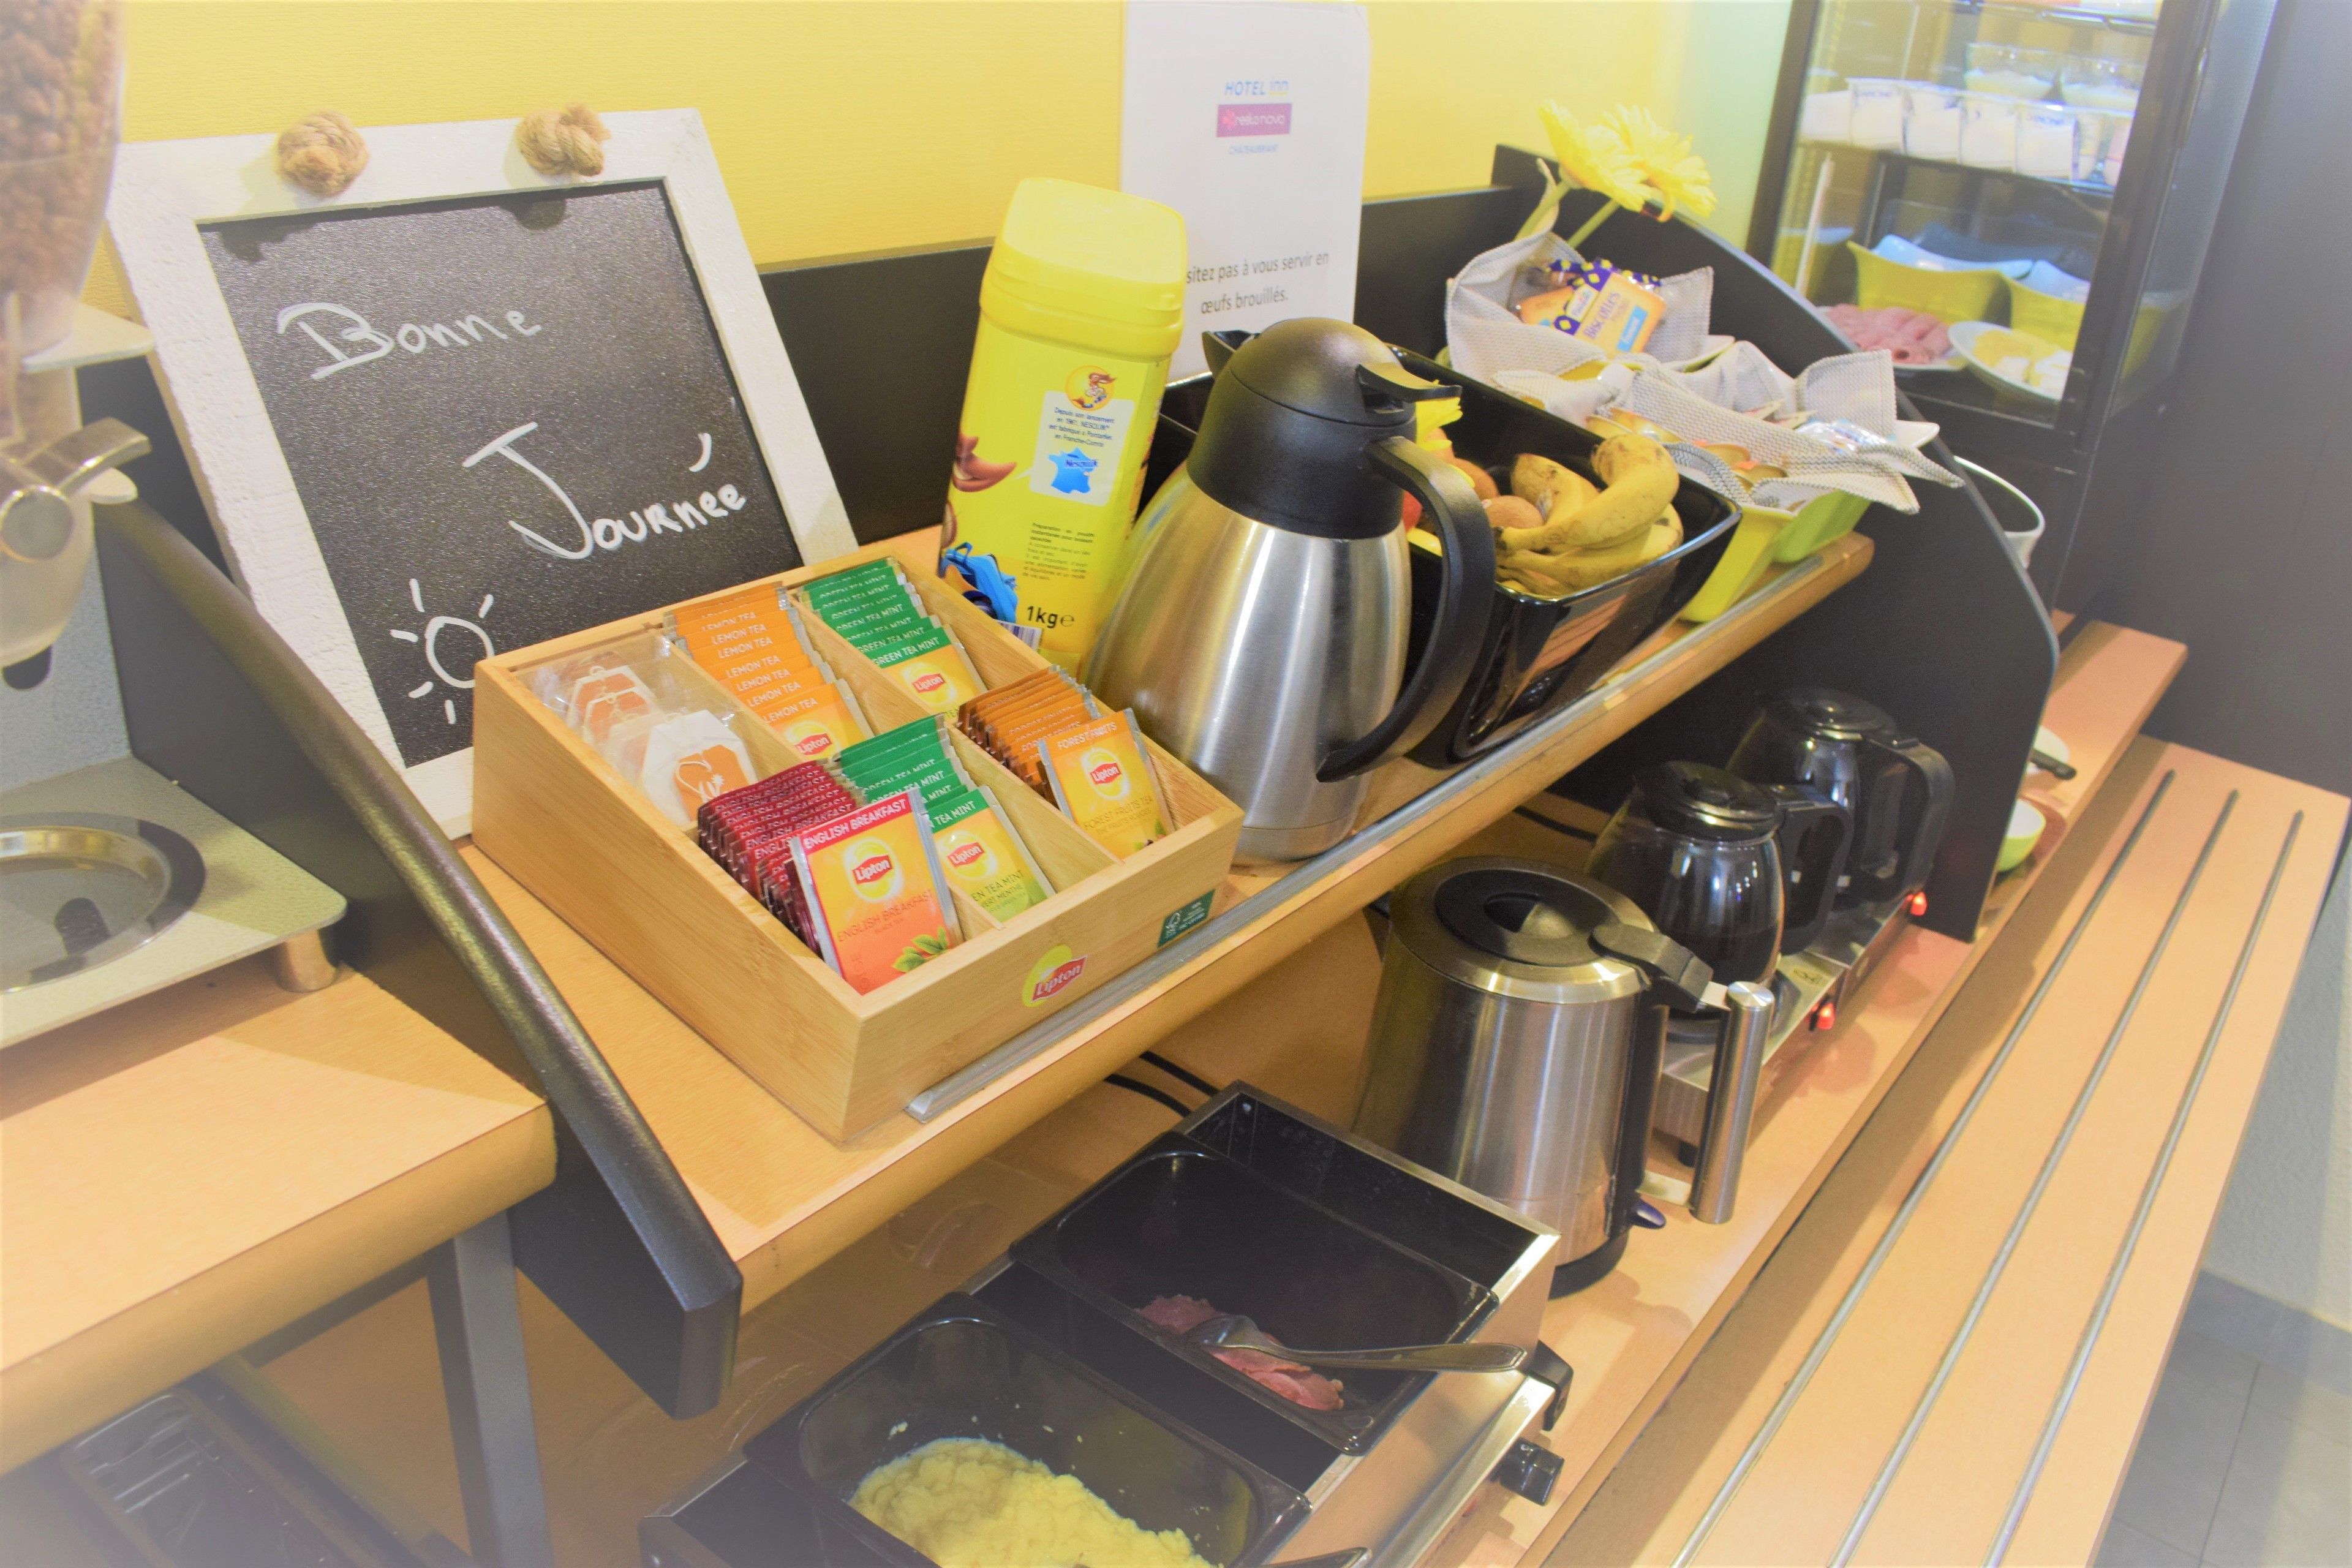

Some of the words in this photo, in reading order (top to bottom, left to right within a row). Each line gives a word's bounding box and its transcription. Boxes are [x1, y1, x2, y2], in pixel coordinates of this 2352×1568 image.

[1224, 80, 1266, 95] HOTEL
[1269, 76, 1289, 92] inn
[1218, 263, 1239, 284] pas
[1242, 258, 1250, 276] à
[1252, 258, 1279, 274] vous
[1282, 251, 1314, 271] servir
[1316, 252, 1330, 266] en
[1235, 285, 1289, 309] brouillés.
[277, 302, 543, 380] Bonne
[711, 627, 747, 645] LEMON
[748, 624, 767, 636] TEA
[858, 639, 887, 654] GREEN
[886, 635, 903, 644] TEA
[902, 627, 925, 639] MINT
[718, 641, 753, 658] LEMON
[754, 636, 774, 647] TEA
[872, 650, 903, 666] GREEN
[902, 646, 919, 657] TEA
[917, 636, 940, 651] MINT
[726, 661, 761, 679] LEMON
[761, 655, 782, 666] TEA
[736, 674, 772, 692] LEMON
[772, 668, 791, 680] TEA
[916, 677, 944, 691] Lipton
[748, 688, 782, 707] LEMON
[782, 682, 802, 693] TEA
[763, 704, 799, 724] LEMON
[799, 698, 818, 710] TEA
[797, 737, 830, 753] Lipton
[1057, 725, 1090, 750] FOREST
[1088, 722, 1117, 740] FRUITS
[920, 770, 945, 787] MINT
[1091, 766, 1120, 782] Lipton
[927, 785, 952, 800] MINT
[802, 822, 850, 850] ENGLISH
[850, 799, 907, 830] BREAKFAST
[933, 813, 954, 826] TEA
[949, 801, 977, 819] MINT
[1084, 810, 1114, 829] FOREST
[1115, 801, 1141, 815] FRUITS
[950, 846, 982, 864] Lipton
[855, 859, 891, 881] Lipton
[984, 882, 1003, 895] TEA
[1001, 869, 1025, 884] MINT
[837, 915, 881, 942] ENGLISH
[1035, 964, 1082, 996] Lipton
